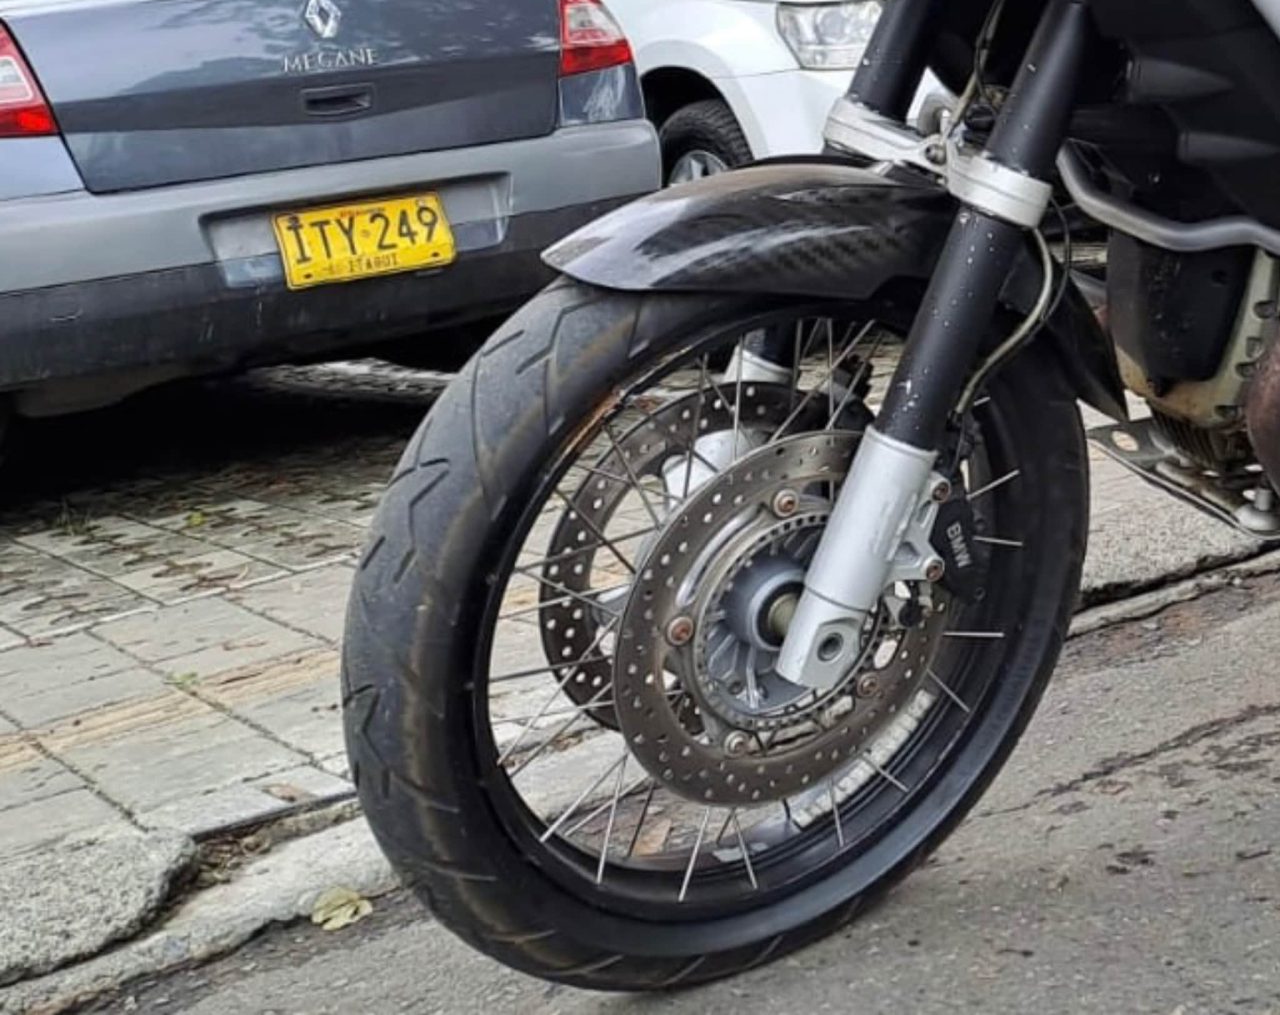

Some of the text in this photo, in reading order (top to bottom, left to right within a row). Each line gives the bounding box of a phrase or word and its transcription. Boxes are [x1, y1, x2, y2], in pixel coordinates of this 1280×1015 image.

[283, 47, 378, 73] MEGANE
[369, 206, 438, 251] 249
[946, 521, 972, 569] BMW
